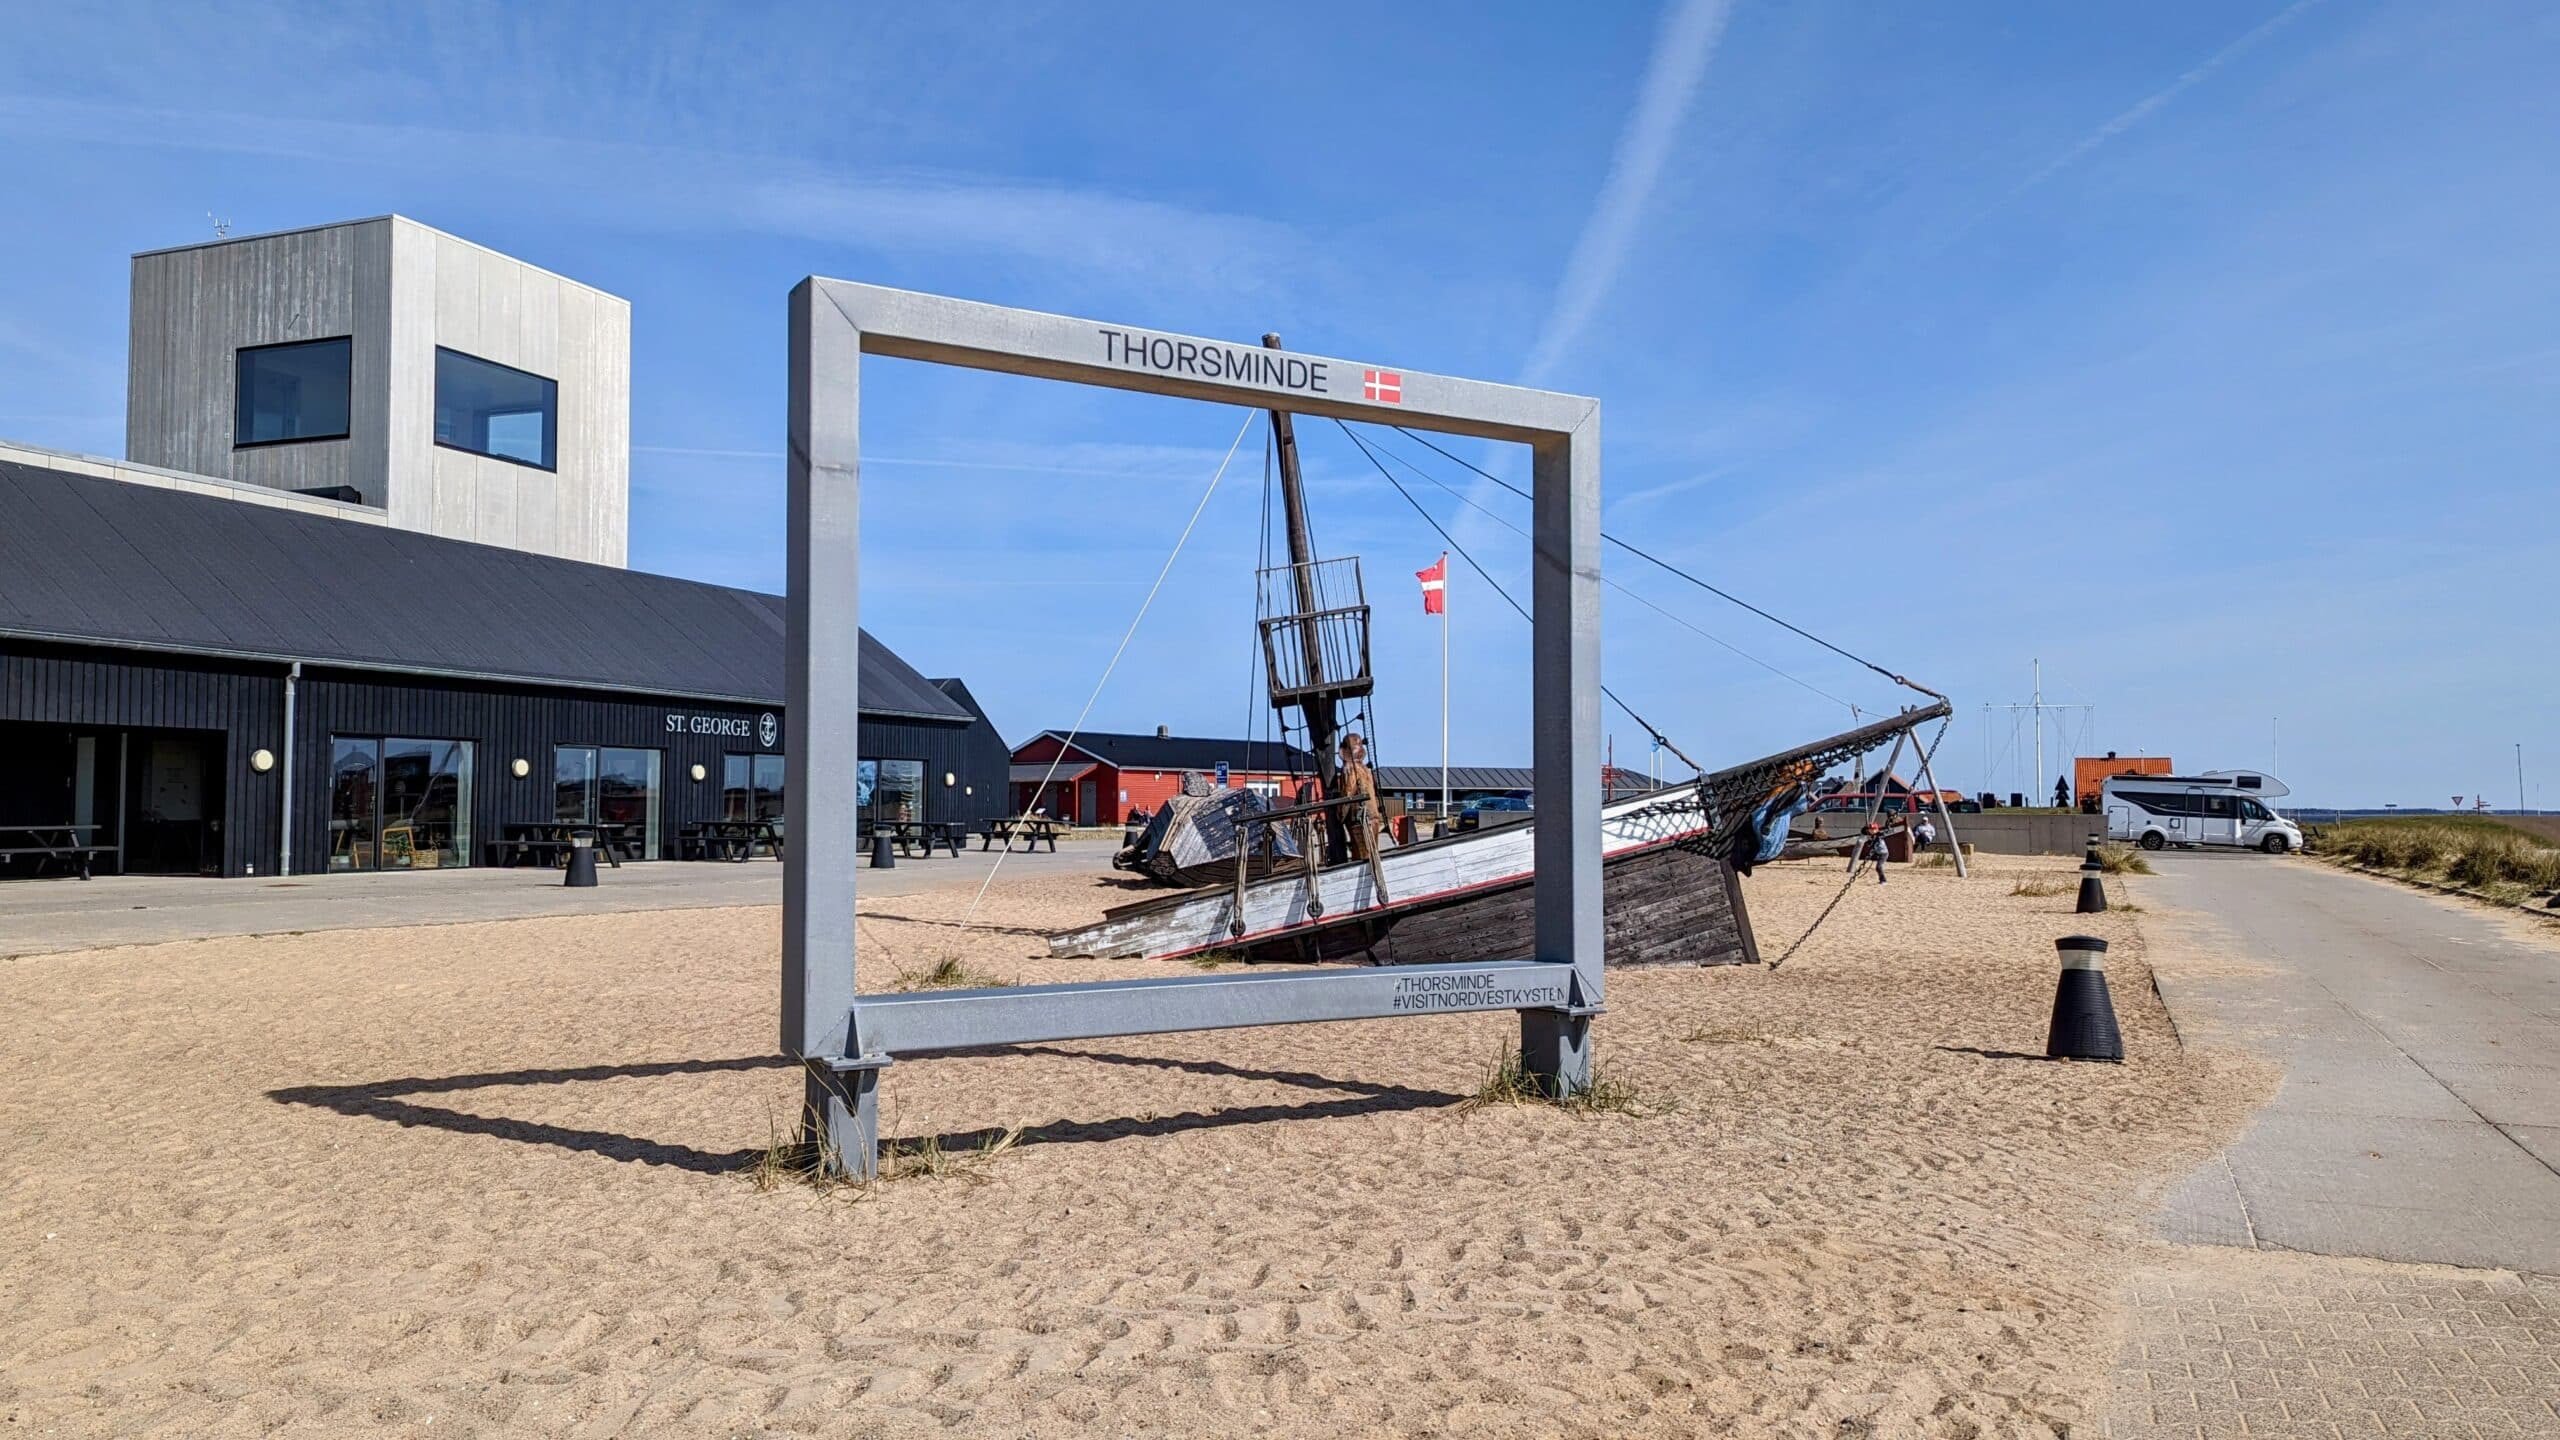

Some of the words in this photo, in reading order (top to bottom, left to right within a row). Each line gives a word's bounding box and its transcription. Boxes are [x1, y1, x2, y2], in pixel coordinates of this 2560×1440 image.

[1099, 330, 1328, 392] THORSMINDE
[666, 714, 687, 732] ST.
[690, 716, 750, 736] GEORGE
